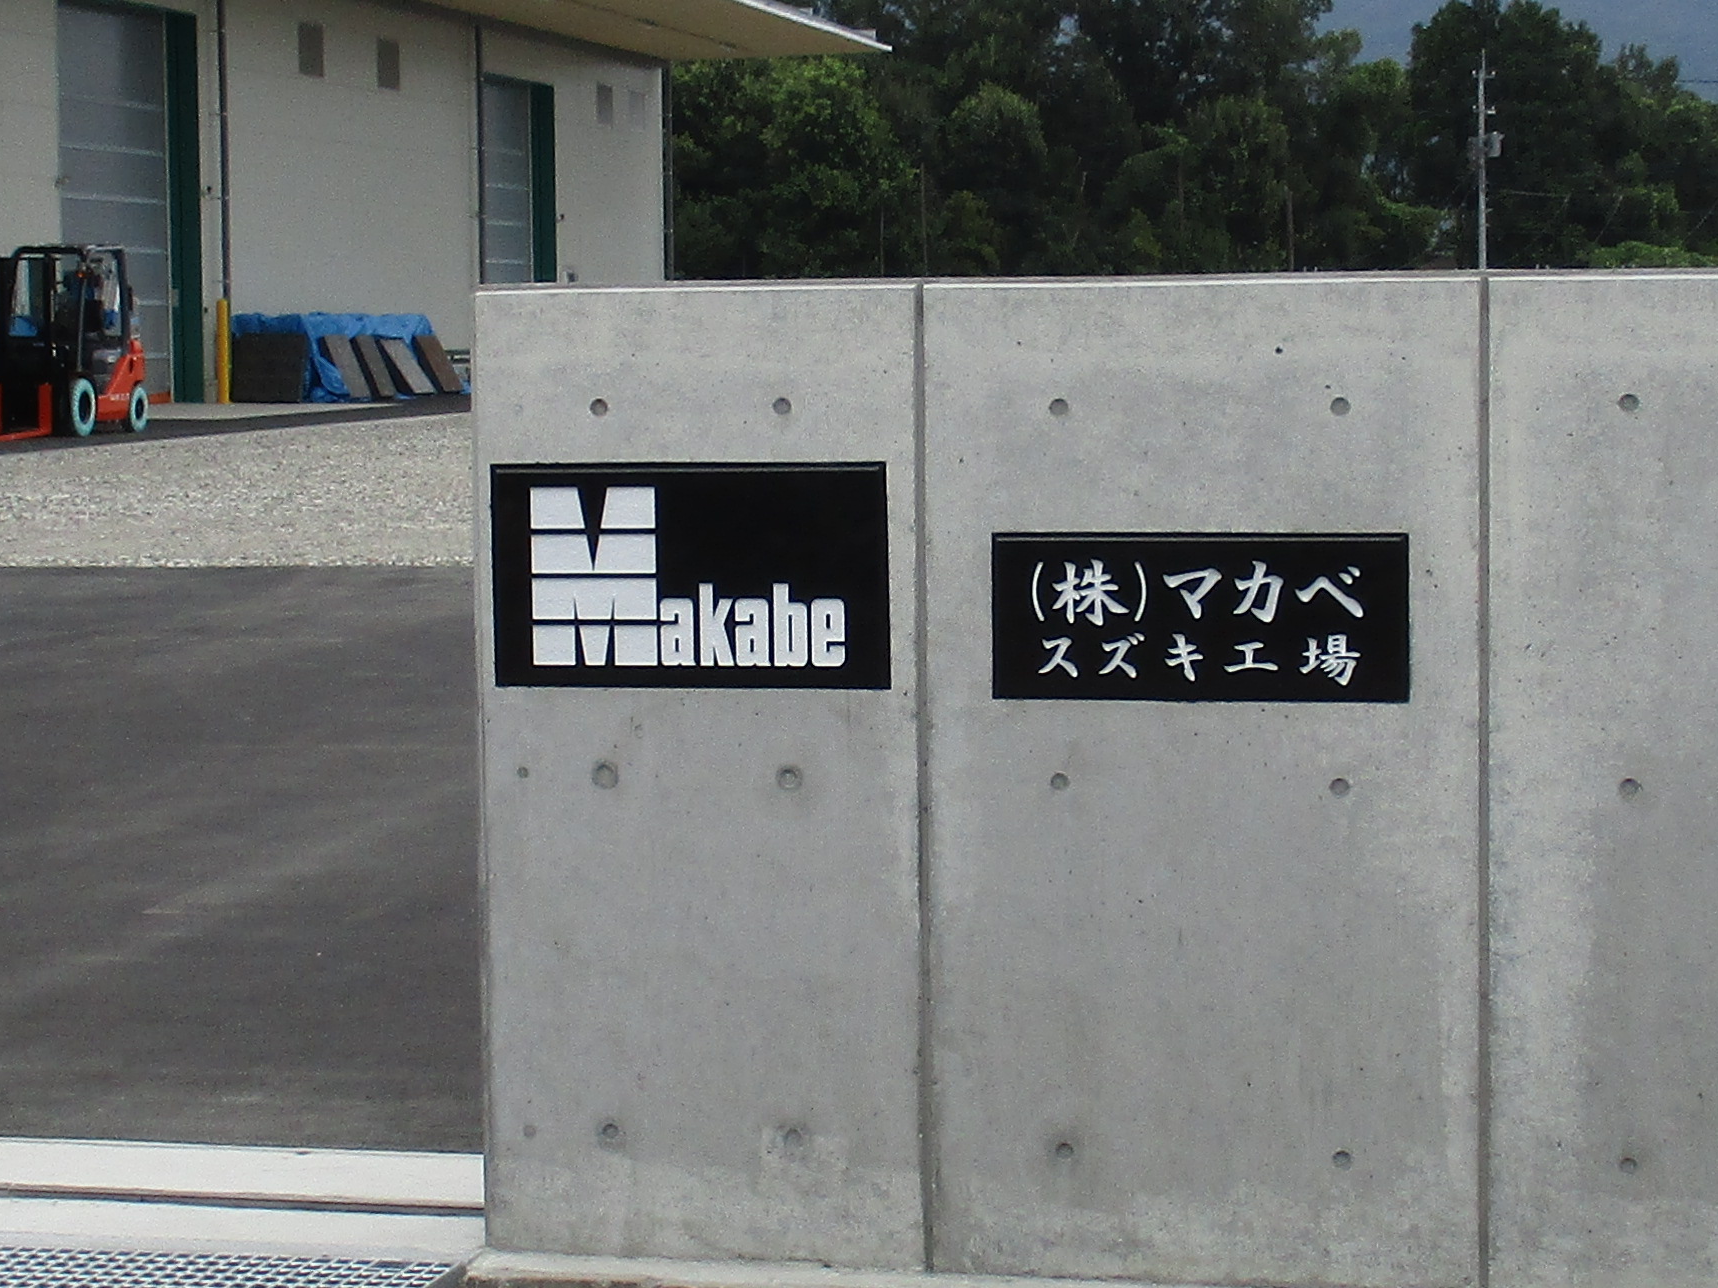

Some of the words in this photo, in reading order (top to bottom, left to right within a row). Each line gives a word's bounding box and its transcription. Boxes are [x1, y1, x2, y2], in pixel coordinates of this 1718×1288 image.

[530, 487, 846, 667] Makabe
[1031, 559, 1364, 626] (株)マカベ
[1038, 632, 1361, 686] スズキ工場
